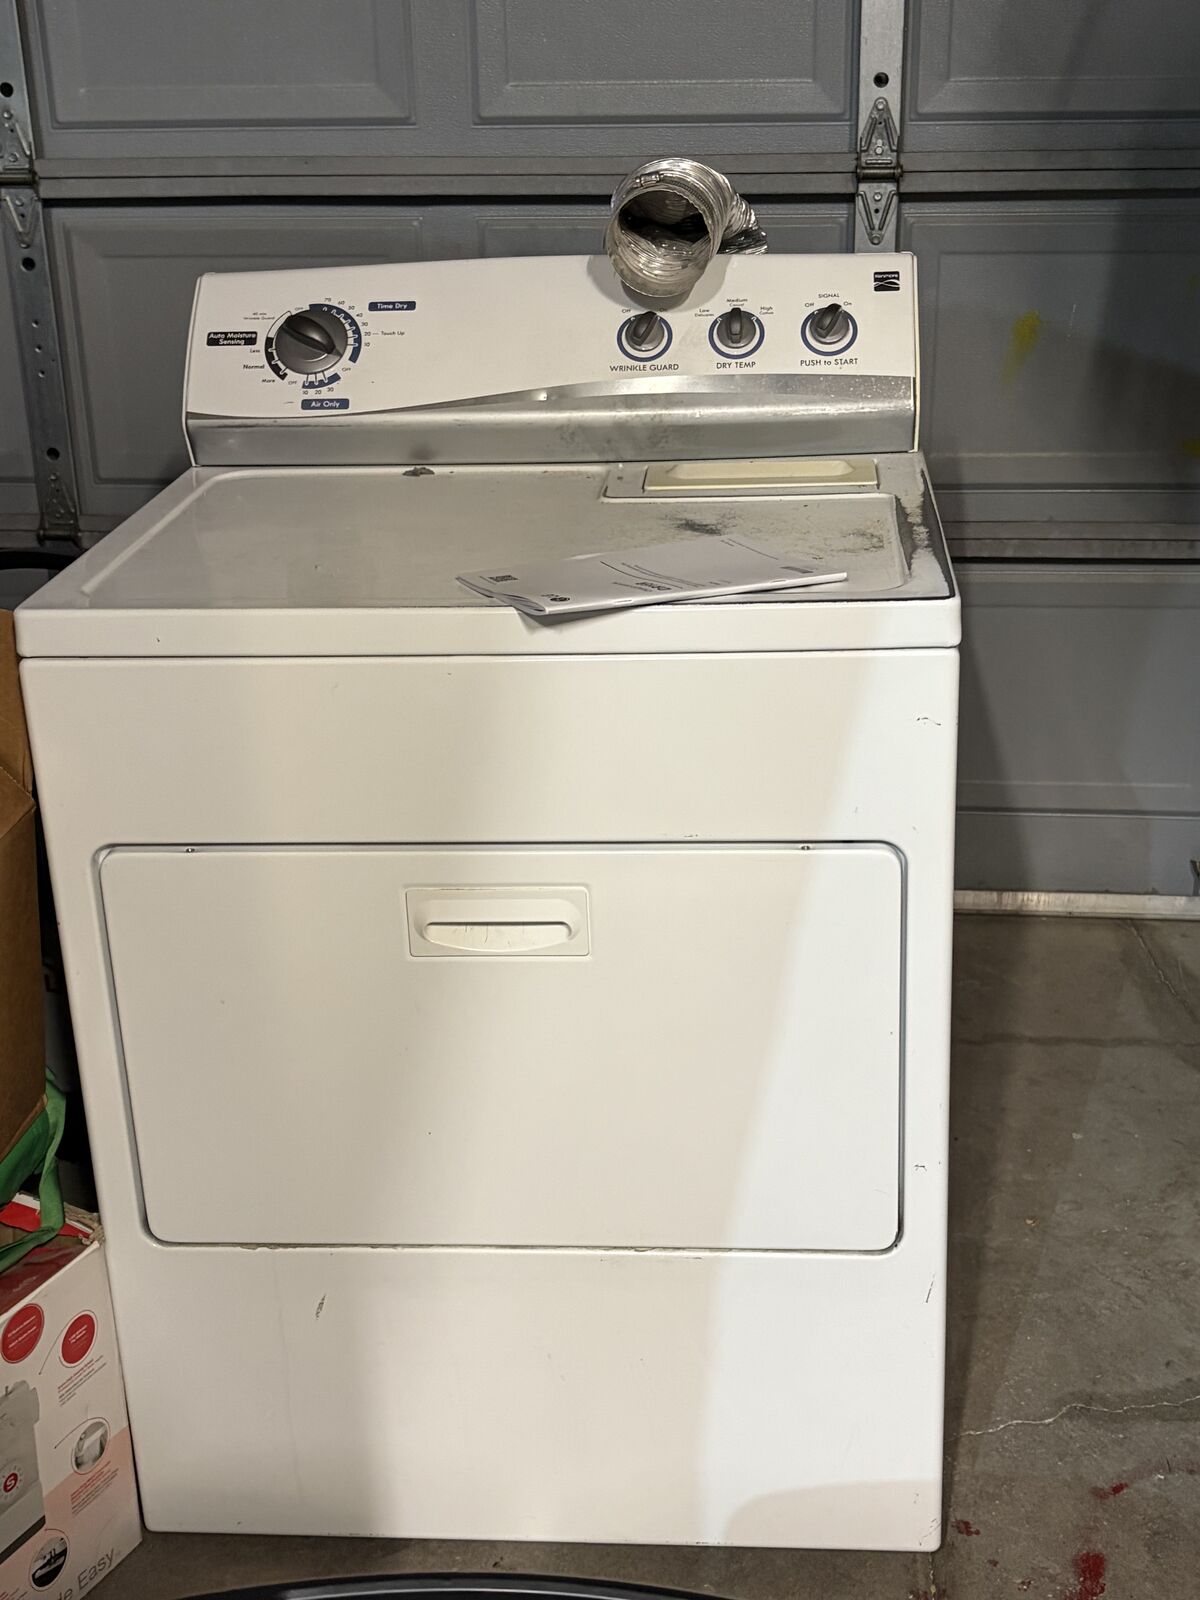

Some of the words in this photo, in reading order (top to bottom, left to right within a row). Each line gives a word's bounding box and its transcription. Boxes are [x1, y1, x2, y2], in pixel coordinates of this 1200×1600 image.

[395, 302, 407, 310] Dry
[735, 361, 756, 369] TEMP
[77, 1548, 114, 1590] Easy
